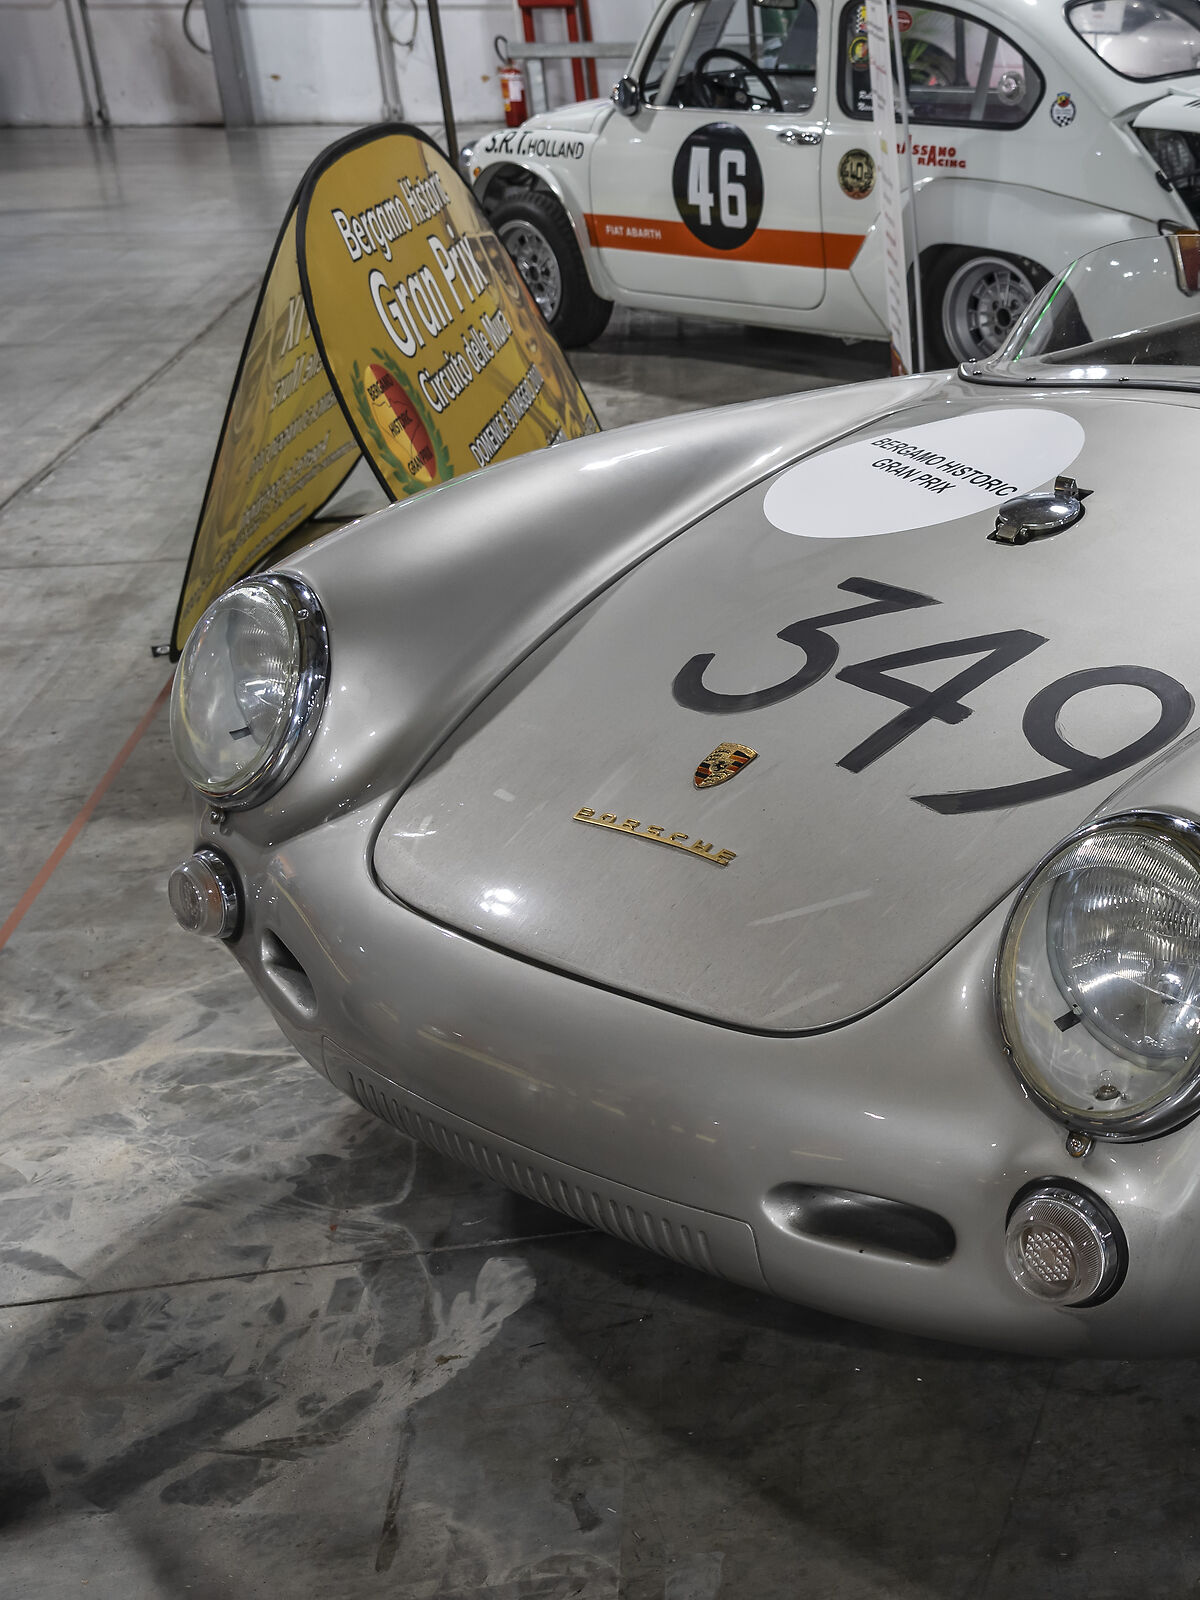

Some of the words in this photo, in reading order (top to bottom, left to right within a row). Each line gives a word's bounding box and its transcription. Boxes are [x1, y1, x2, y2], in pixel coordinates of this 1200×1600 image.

[485, 131, 526, 155] S.R.T.
[526, 139, 585, 160] HOLLAND
[917, 153, 966, 168] RACING
[688, 146, 747, 229] 46
[331, 194, 413, 262] Bergamo
[606, 224, 624, 236] FIAT
[626, 226, 662, 240] ABARTH
[368, 264, 454, 357] Gran
[426, 223, 490, 314] Prix
[417, 350, 474, 413] Circuito
[461, 323, 495, 374] delle
[480, 307, 513, 352] Mura
[468, 410, 512, 468] DOMENICA
[871, 437, 946, 466] BERGAMO
[936, 460, 1018, 497] HISTORIC
[872, 458, 921, 480] GRAN
[909, 473, 956, 494] PRIX
[671, 576, 1196, 815] 349
[573, 807, 737, 866] PORSCHE
